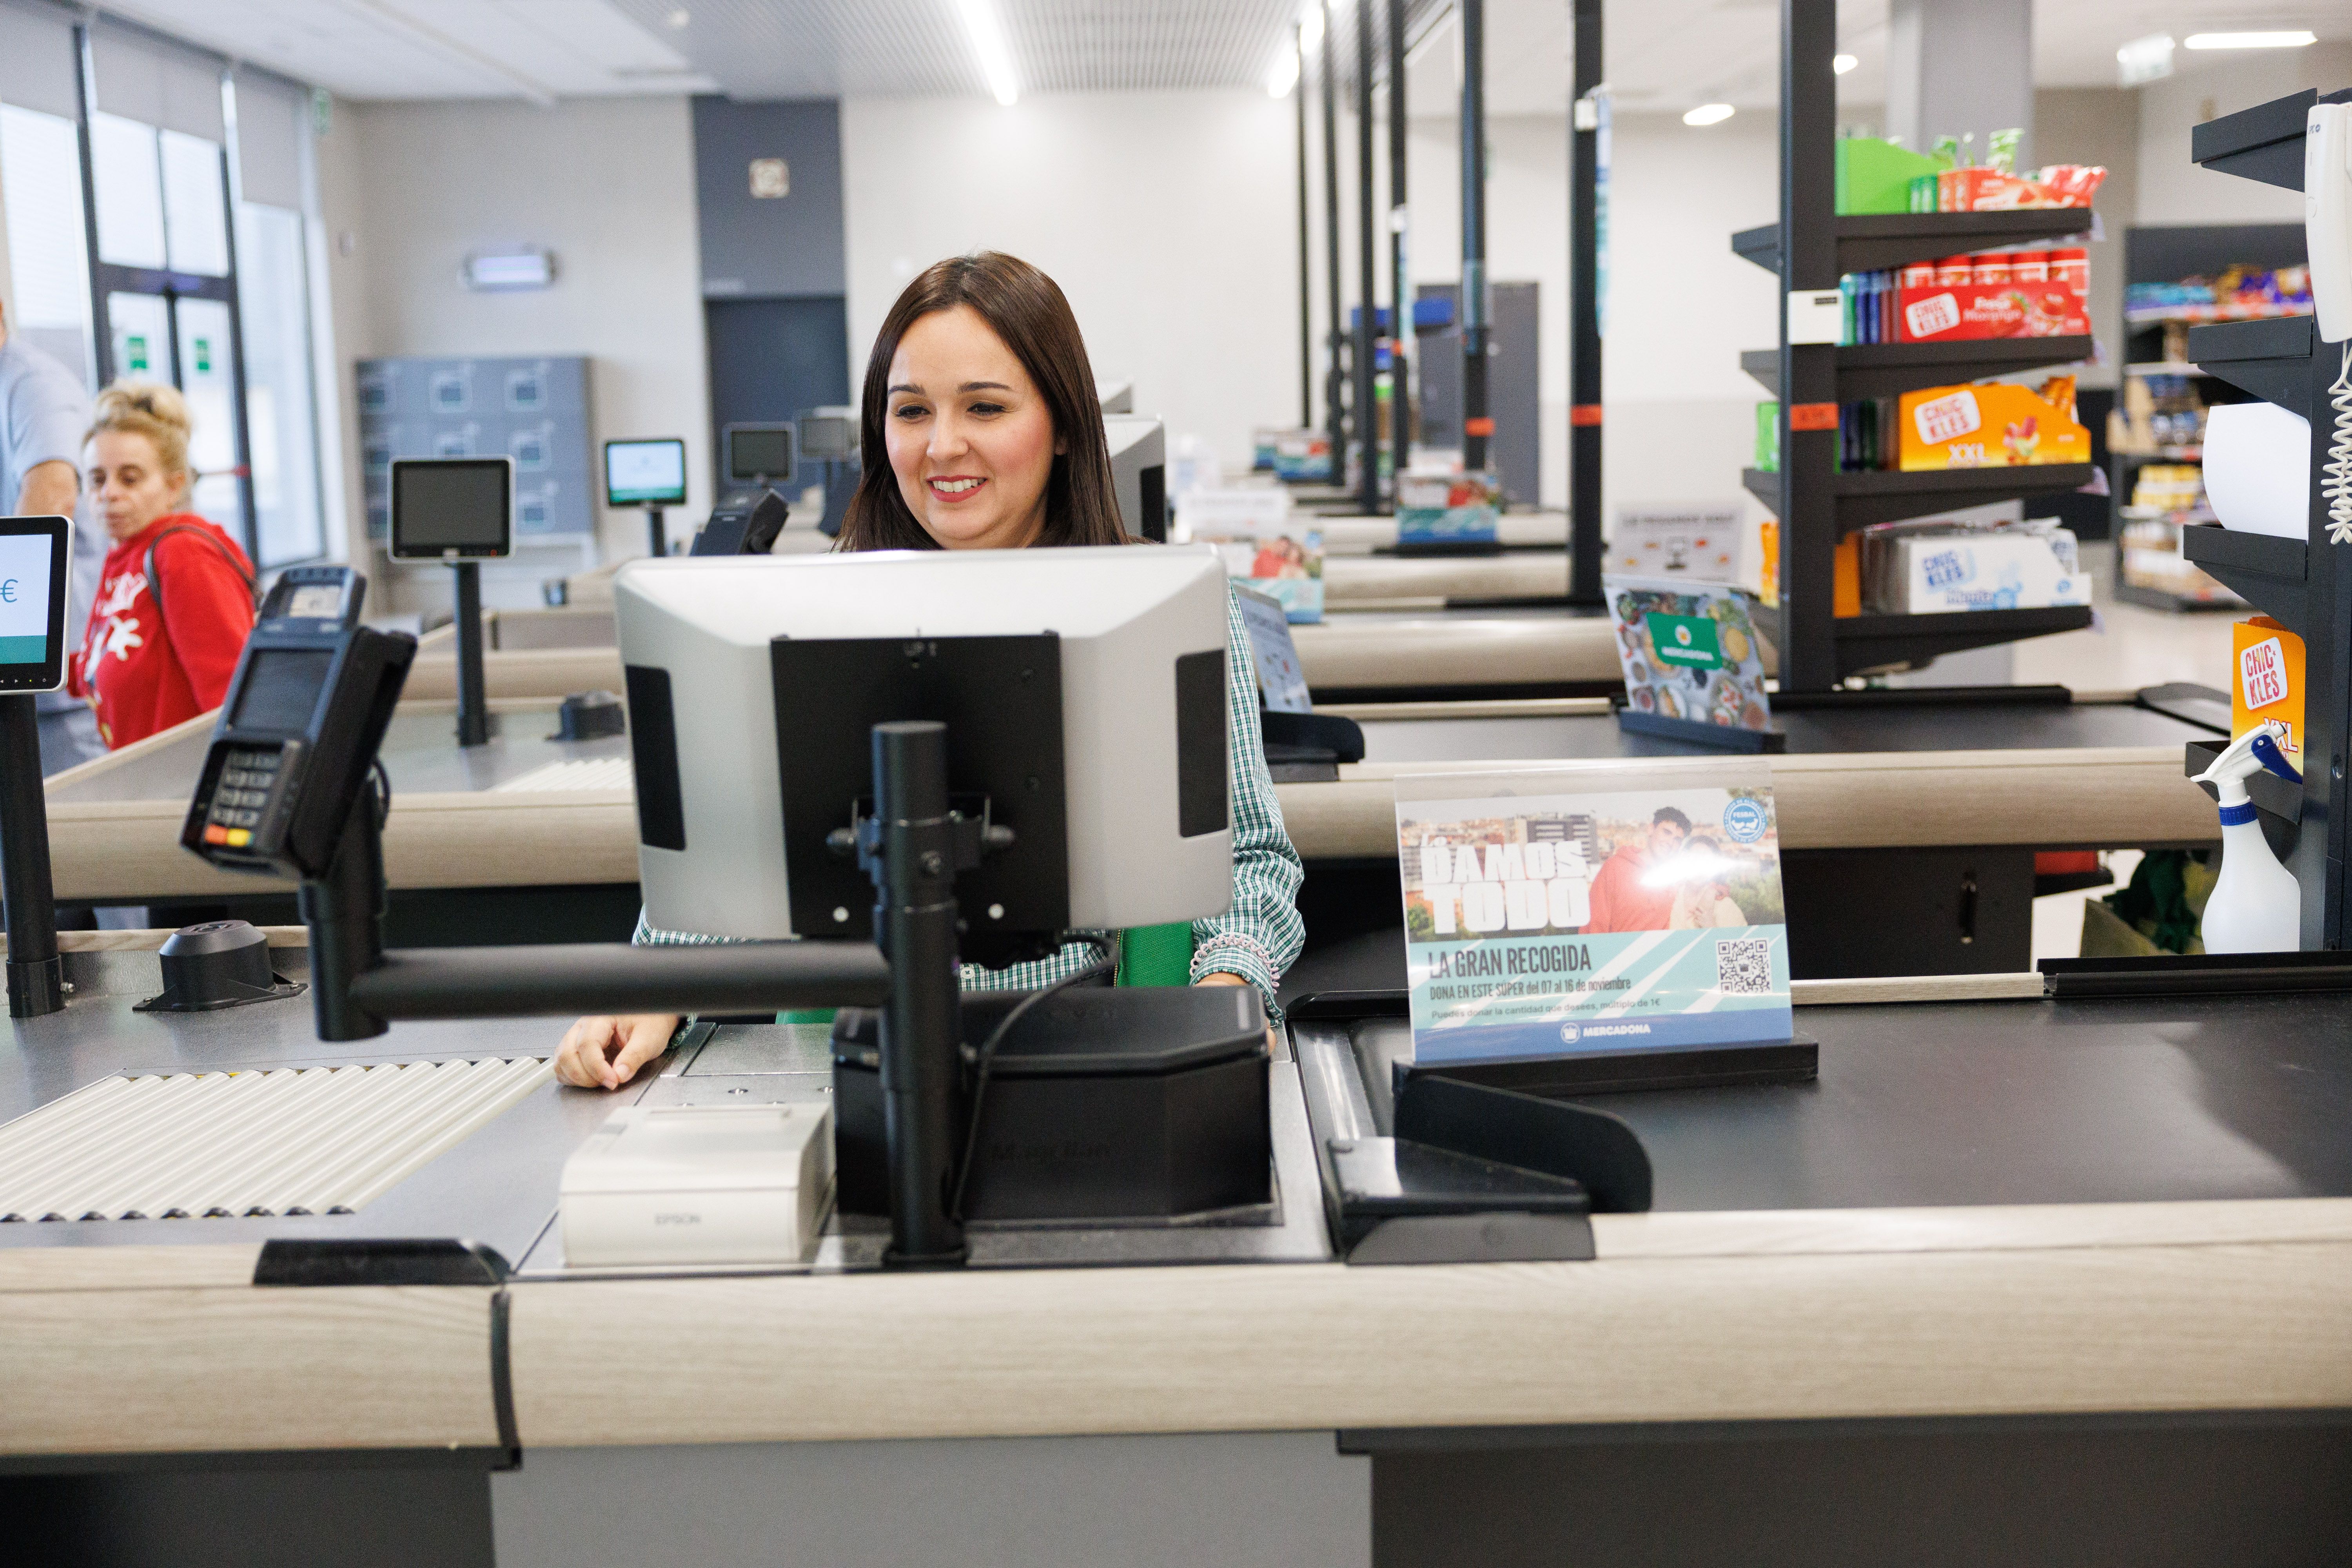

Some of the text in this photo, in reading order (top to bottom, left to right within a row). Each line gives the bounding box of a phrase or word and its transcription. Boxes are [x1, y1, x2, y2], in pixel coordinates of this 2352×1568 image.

[1948, 443, 1989, 463] XXL
[2245, 644, 2274, 677] CHIC
[2249, 670, 2280, 705] KLES
[1420, 840, 1587, 883] DAMOS
[1423, 877, 1591, 934] TODO
[1428, 944, 1592, 978] LA GRAN RECOGIDA
[1430, 976, 1631, 1000] DONA EN ESTE SÚPER del 07 al 16 de noviembre
[1432, 1010, 1464, 1019] Puedes
[1467, 1008, 1493, 1017] donar
[1505, 1004, 1543, 1014] cantidad
[1637, 998, 1648, 1007] de
[1651, 998, 1661, 1007] 1€
[1583, 1023, 1651, 1038] MERCADONA
